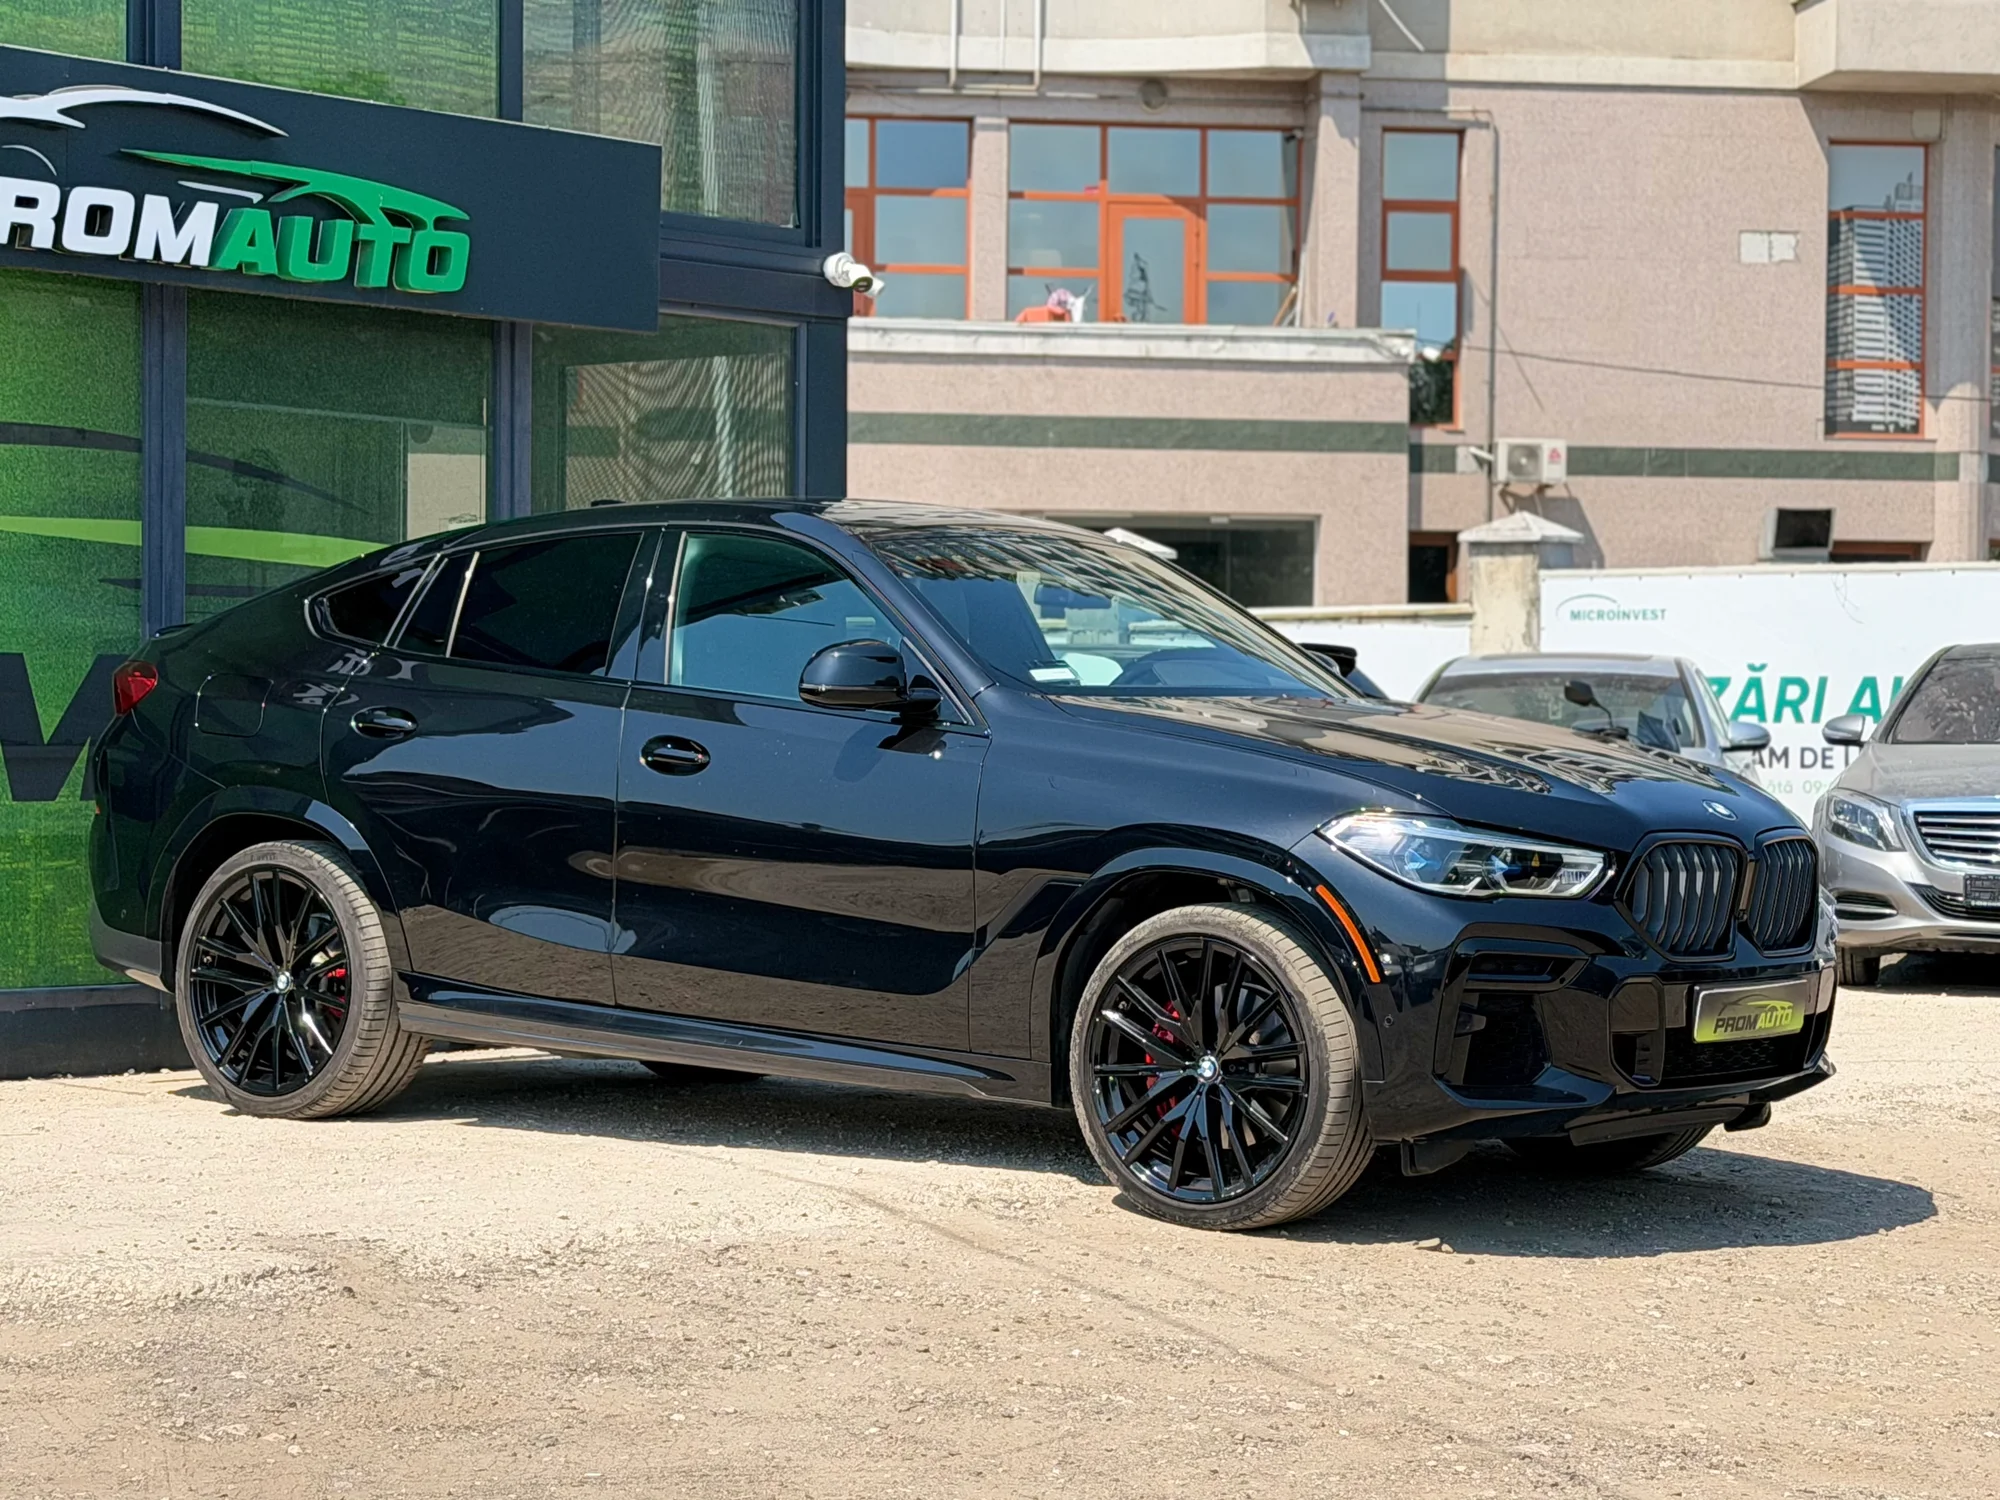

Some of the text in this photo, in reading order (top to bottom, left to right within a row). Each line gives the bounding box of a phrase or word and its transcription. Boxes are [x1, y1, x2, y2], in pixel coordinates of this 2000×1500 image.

[1570, 605, 1667, 621] MICROINVEST
[1845, 675, 1904, 724] A
[1800, 746, 1835, 769] DE
[1713, 1007, 1793, 1035] PROMAUTO
